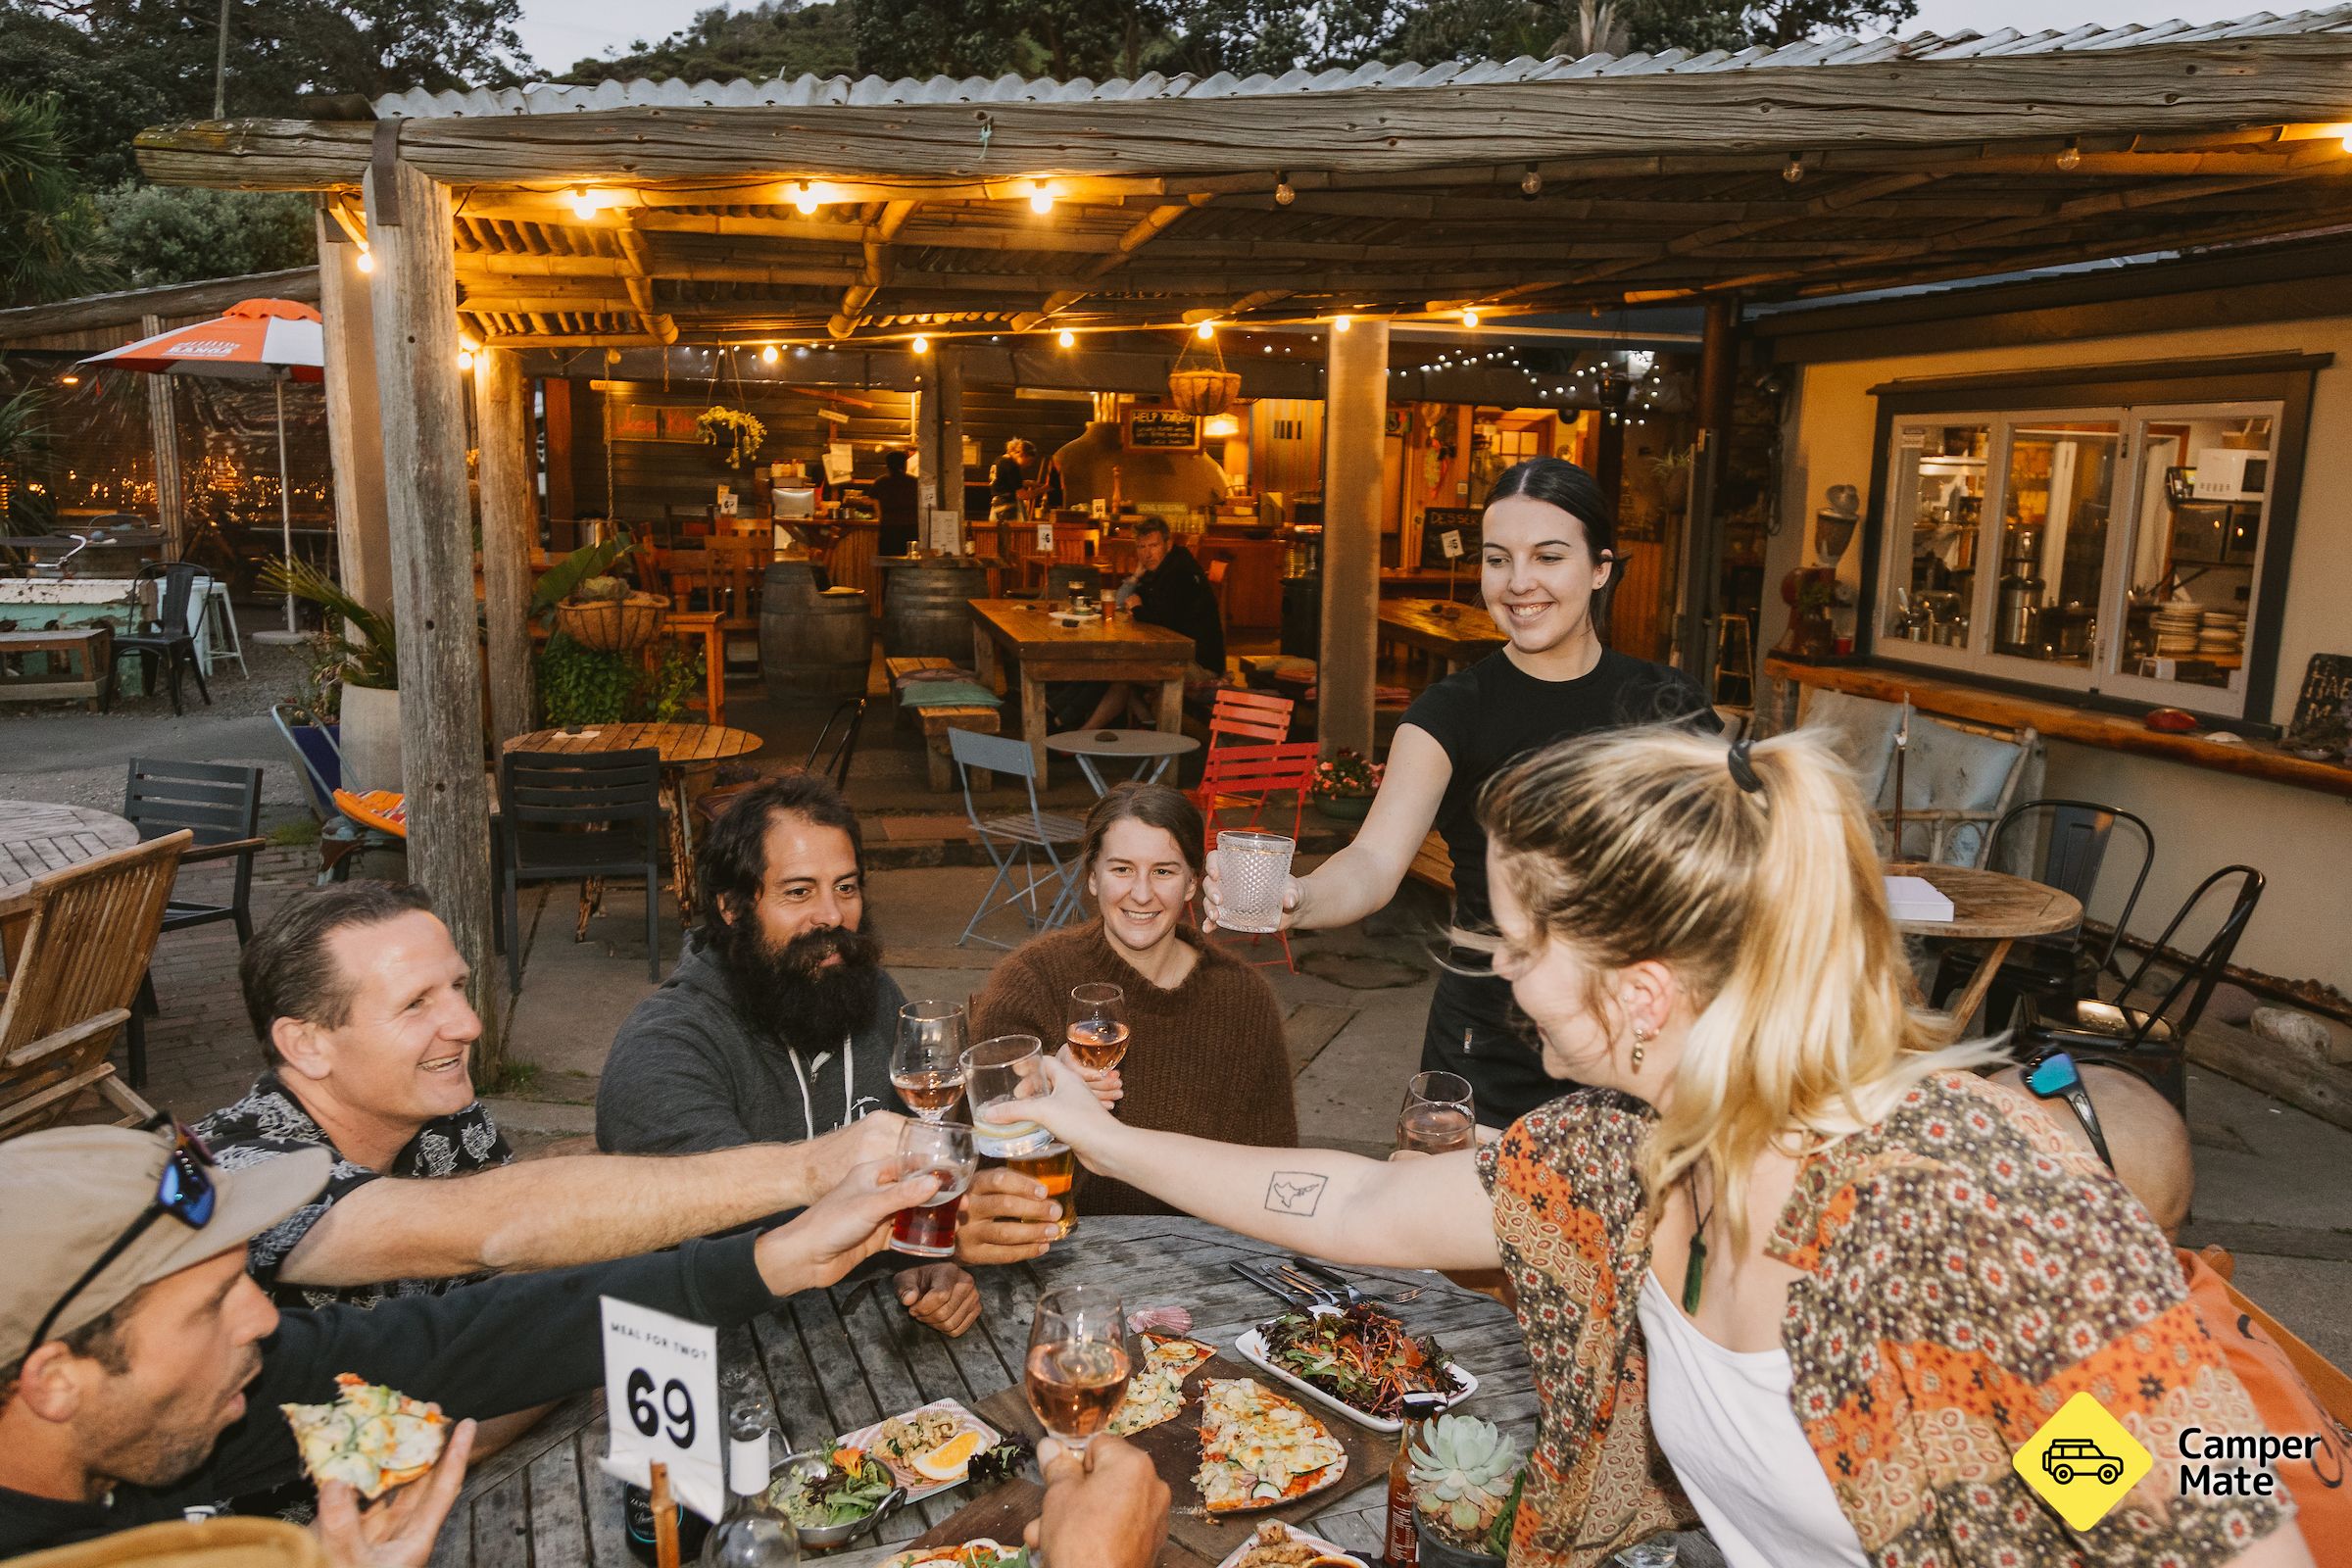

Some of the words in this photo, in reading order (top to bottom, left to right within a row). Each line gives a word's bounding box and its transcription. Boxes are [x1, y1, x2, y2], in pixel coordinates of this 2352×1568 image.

[1132, 412, 1157, 422] HELP
[1431, 512, 1484, 526] DESSER
[611, 1322, 641, 1341] MEAL
[645, 1333, 668, 1348] FOR
[673, 1342, 709, 1361] TWO?
[627, 1367, 696, 1449] 69
